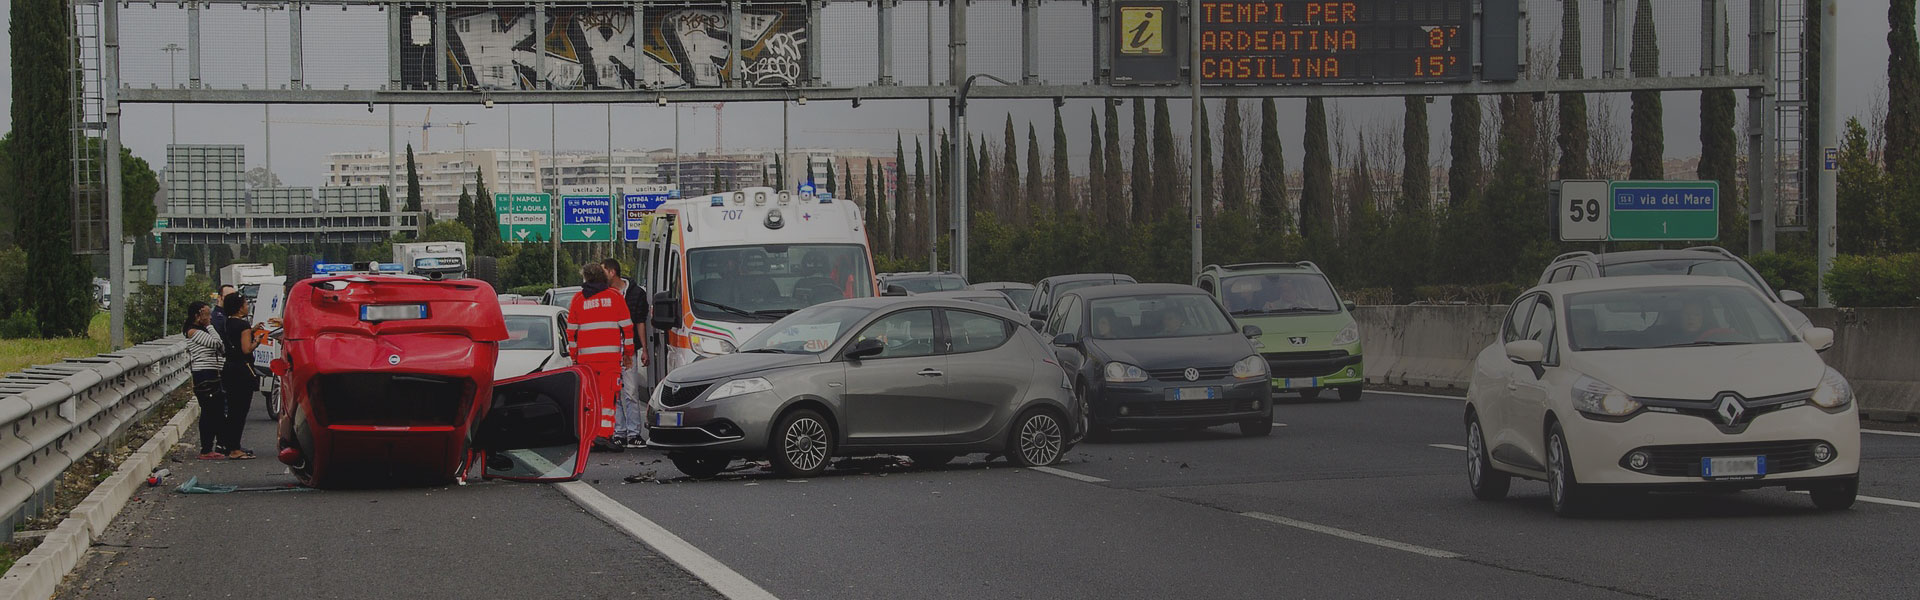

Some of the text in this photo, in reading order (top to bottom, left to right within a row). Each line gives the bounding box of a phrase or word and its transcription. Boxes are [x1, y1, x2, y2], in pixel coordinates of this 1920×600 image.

[1202, 3, 1358, 23] TEMPI PER
[1202, 30, 1357, 51] ARDEATINA
[1202, 56, 1457, 79] CASILINA 15'
[1639, 194, 1656, 205] via
[1661, 194, 1679, 205] del
[1684, 194, 1711, 205] Mare
[721, 209, 744, 221] 707
[1569, 199, 1601, 223] 59
[1662, 220, 1668, 234] 1
